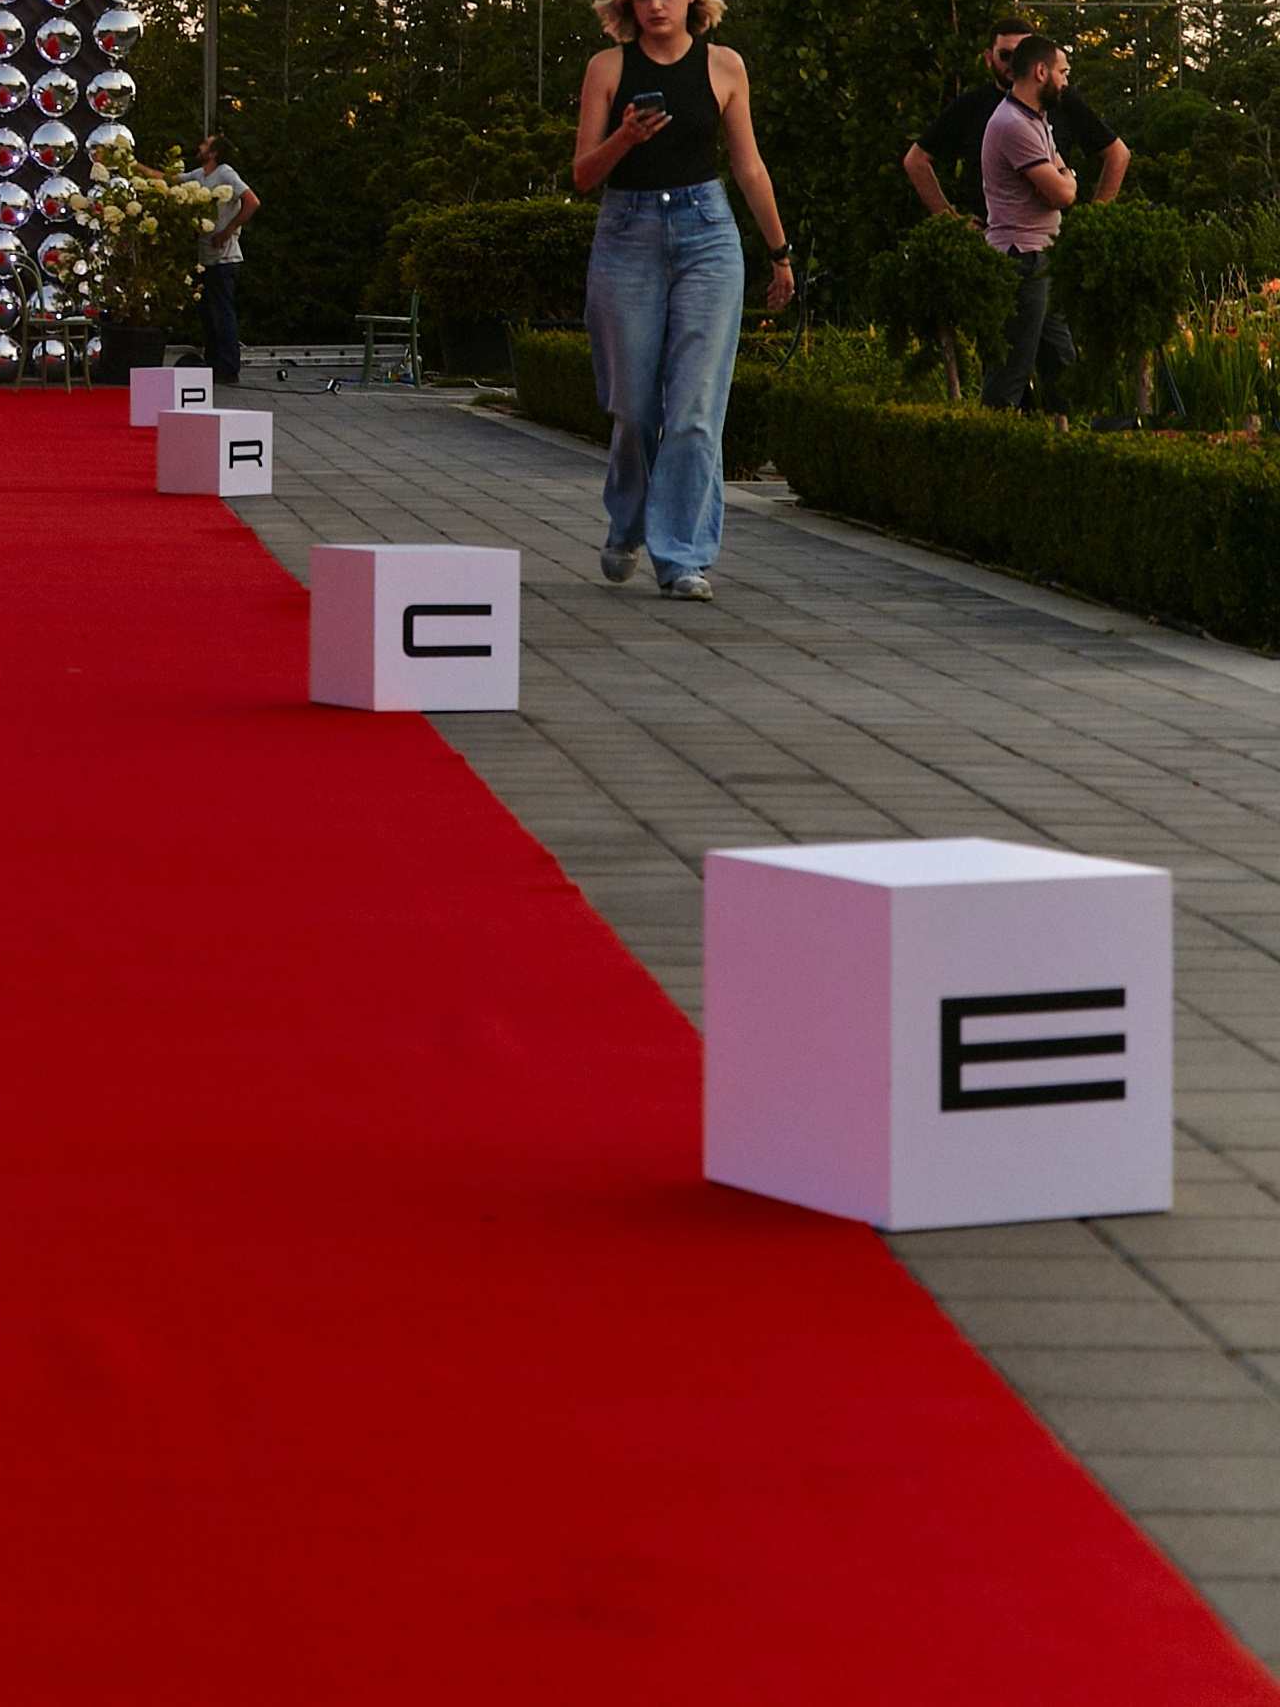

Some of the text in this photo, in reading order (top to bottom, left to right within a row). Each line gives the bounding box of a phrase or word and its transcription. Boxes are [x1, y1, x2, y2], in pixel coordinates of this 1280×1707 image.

[181, 387, 206, 408] P
[229, 439, 263, 469] R
[402, 604, 492, 658] C
[940, 987, 1126, 1113] E
